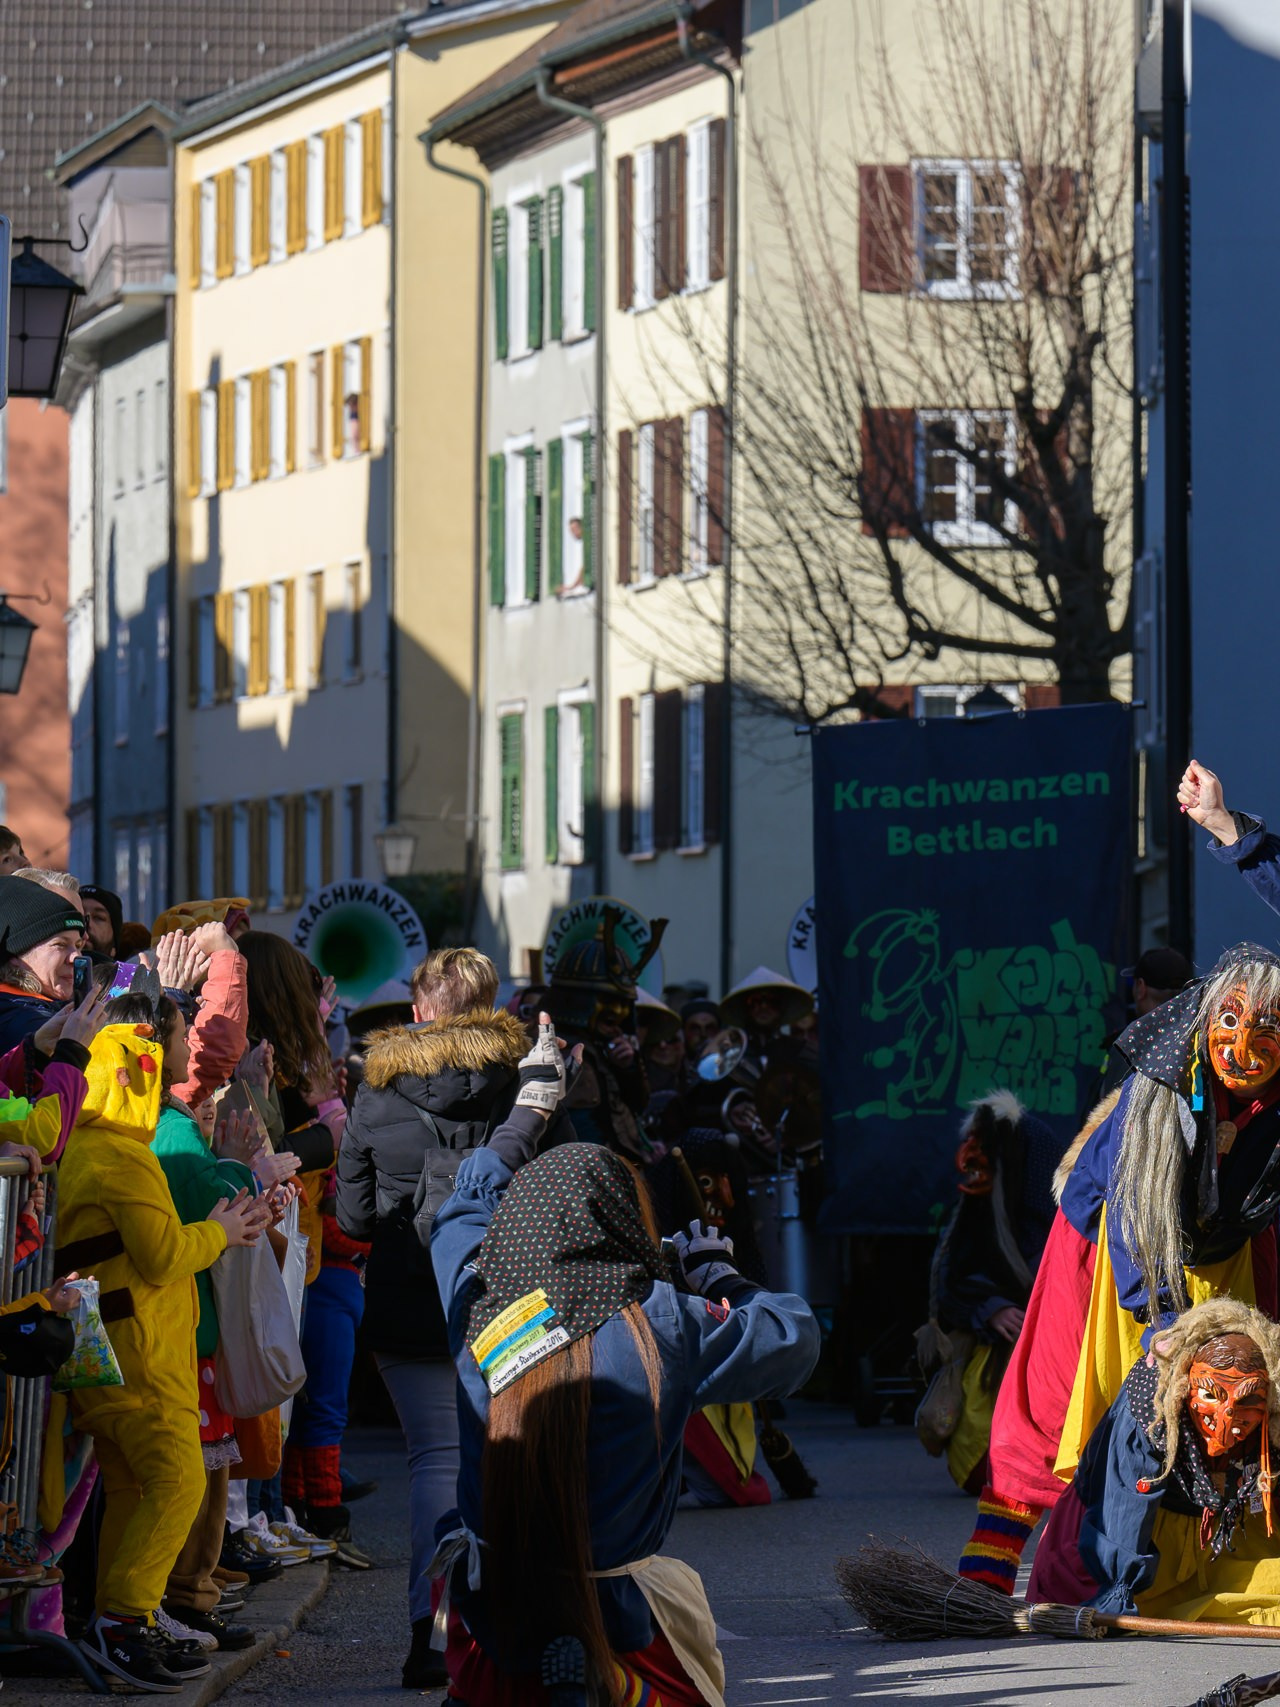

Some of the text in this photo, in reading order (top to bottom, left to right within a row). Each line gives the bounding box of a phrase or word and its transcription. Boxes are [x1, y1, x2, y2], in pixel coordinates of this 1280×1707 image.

[834, 770, 1110, 811] Krachwanzen
[887, 816, 1058, 856] Bettlach
[294, 884, 422, 949] KRACHWANZEN
[547, 1332, 564, 1348] 2016
[113, 1647, 131, 1662] FILA
